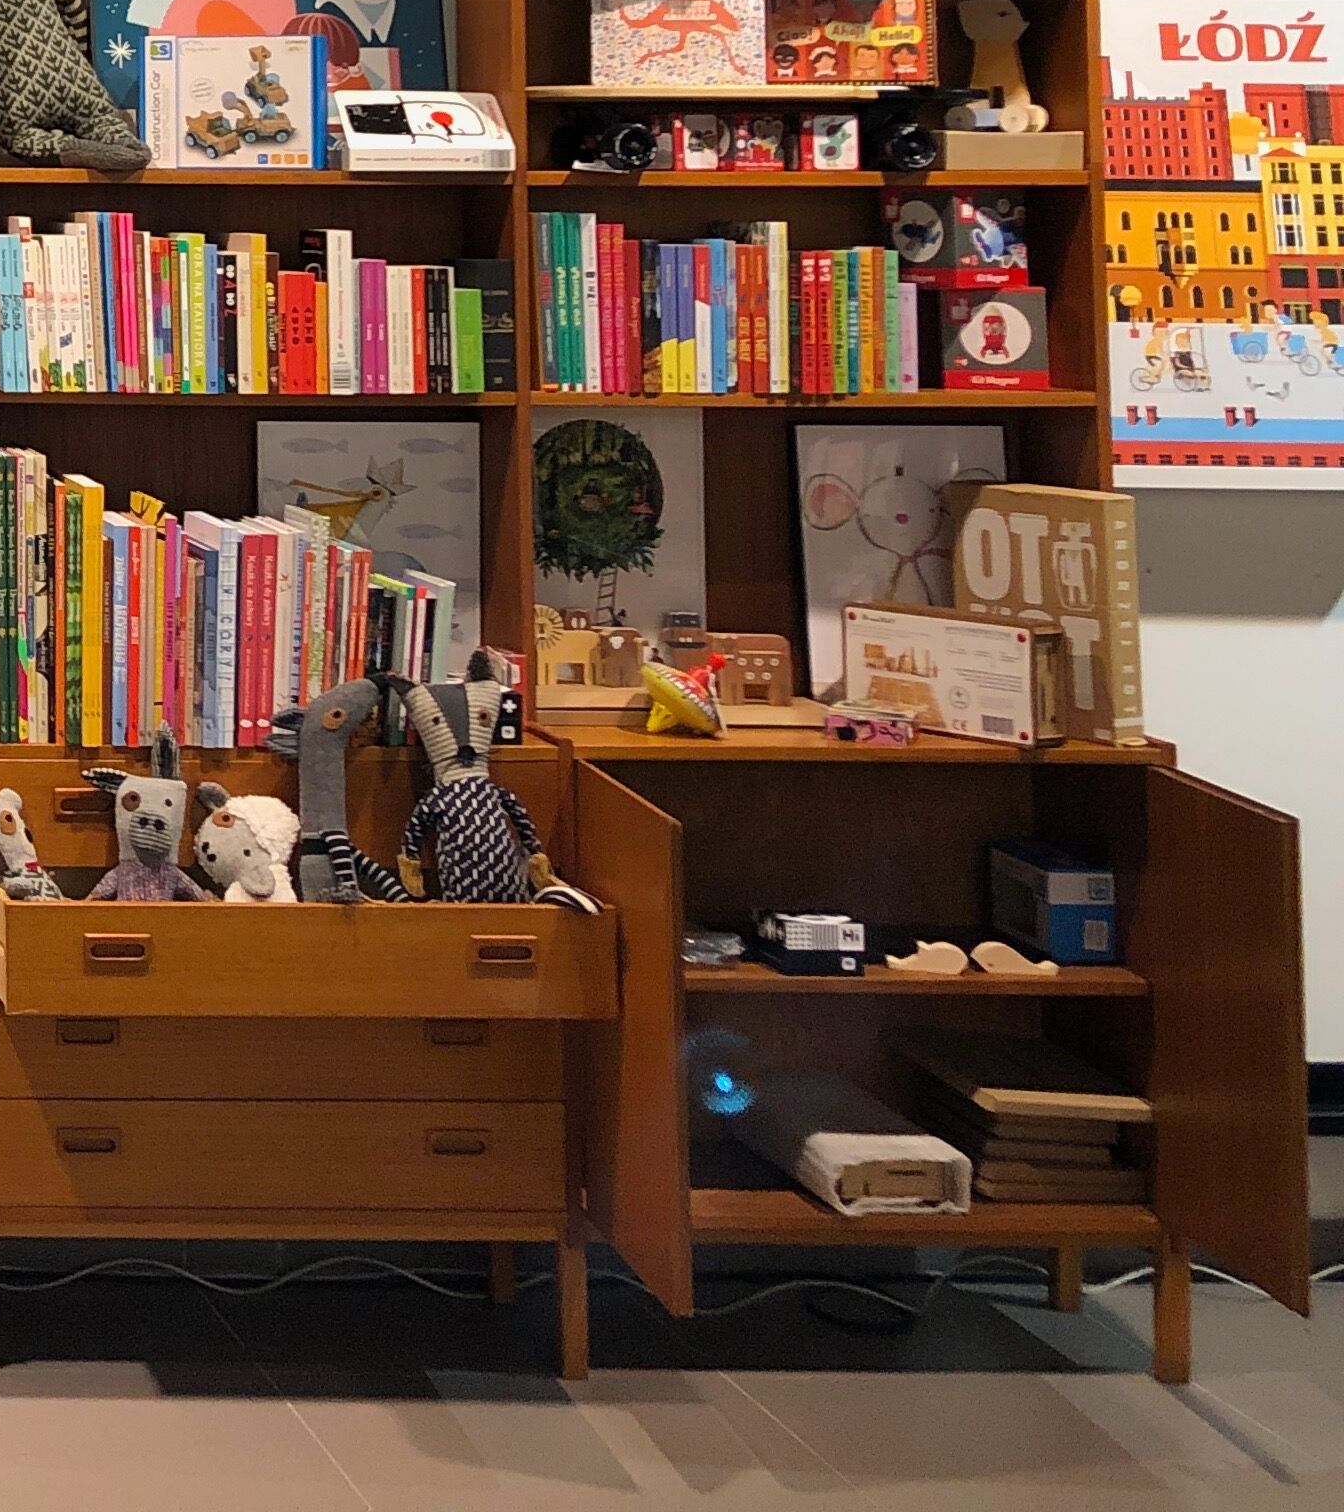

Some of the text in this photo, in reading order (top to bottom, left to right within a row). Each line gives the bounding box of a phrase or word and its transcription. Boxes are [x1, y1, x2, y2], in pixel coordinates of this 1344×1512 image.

[777, 30, 813, 42] Ciao!
[831, 24, 865, 39] Ahoj!
[878, 30, 915, 42] Hello!
[1158, 8, 1329, 64] ŁÓDŹ
[151, 71, 161, 161] Construction Car
[226, 265, 235, 279] OD
[194, 282, 202, 296] NA
[224, 280, 236, 289] A
